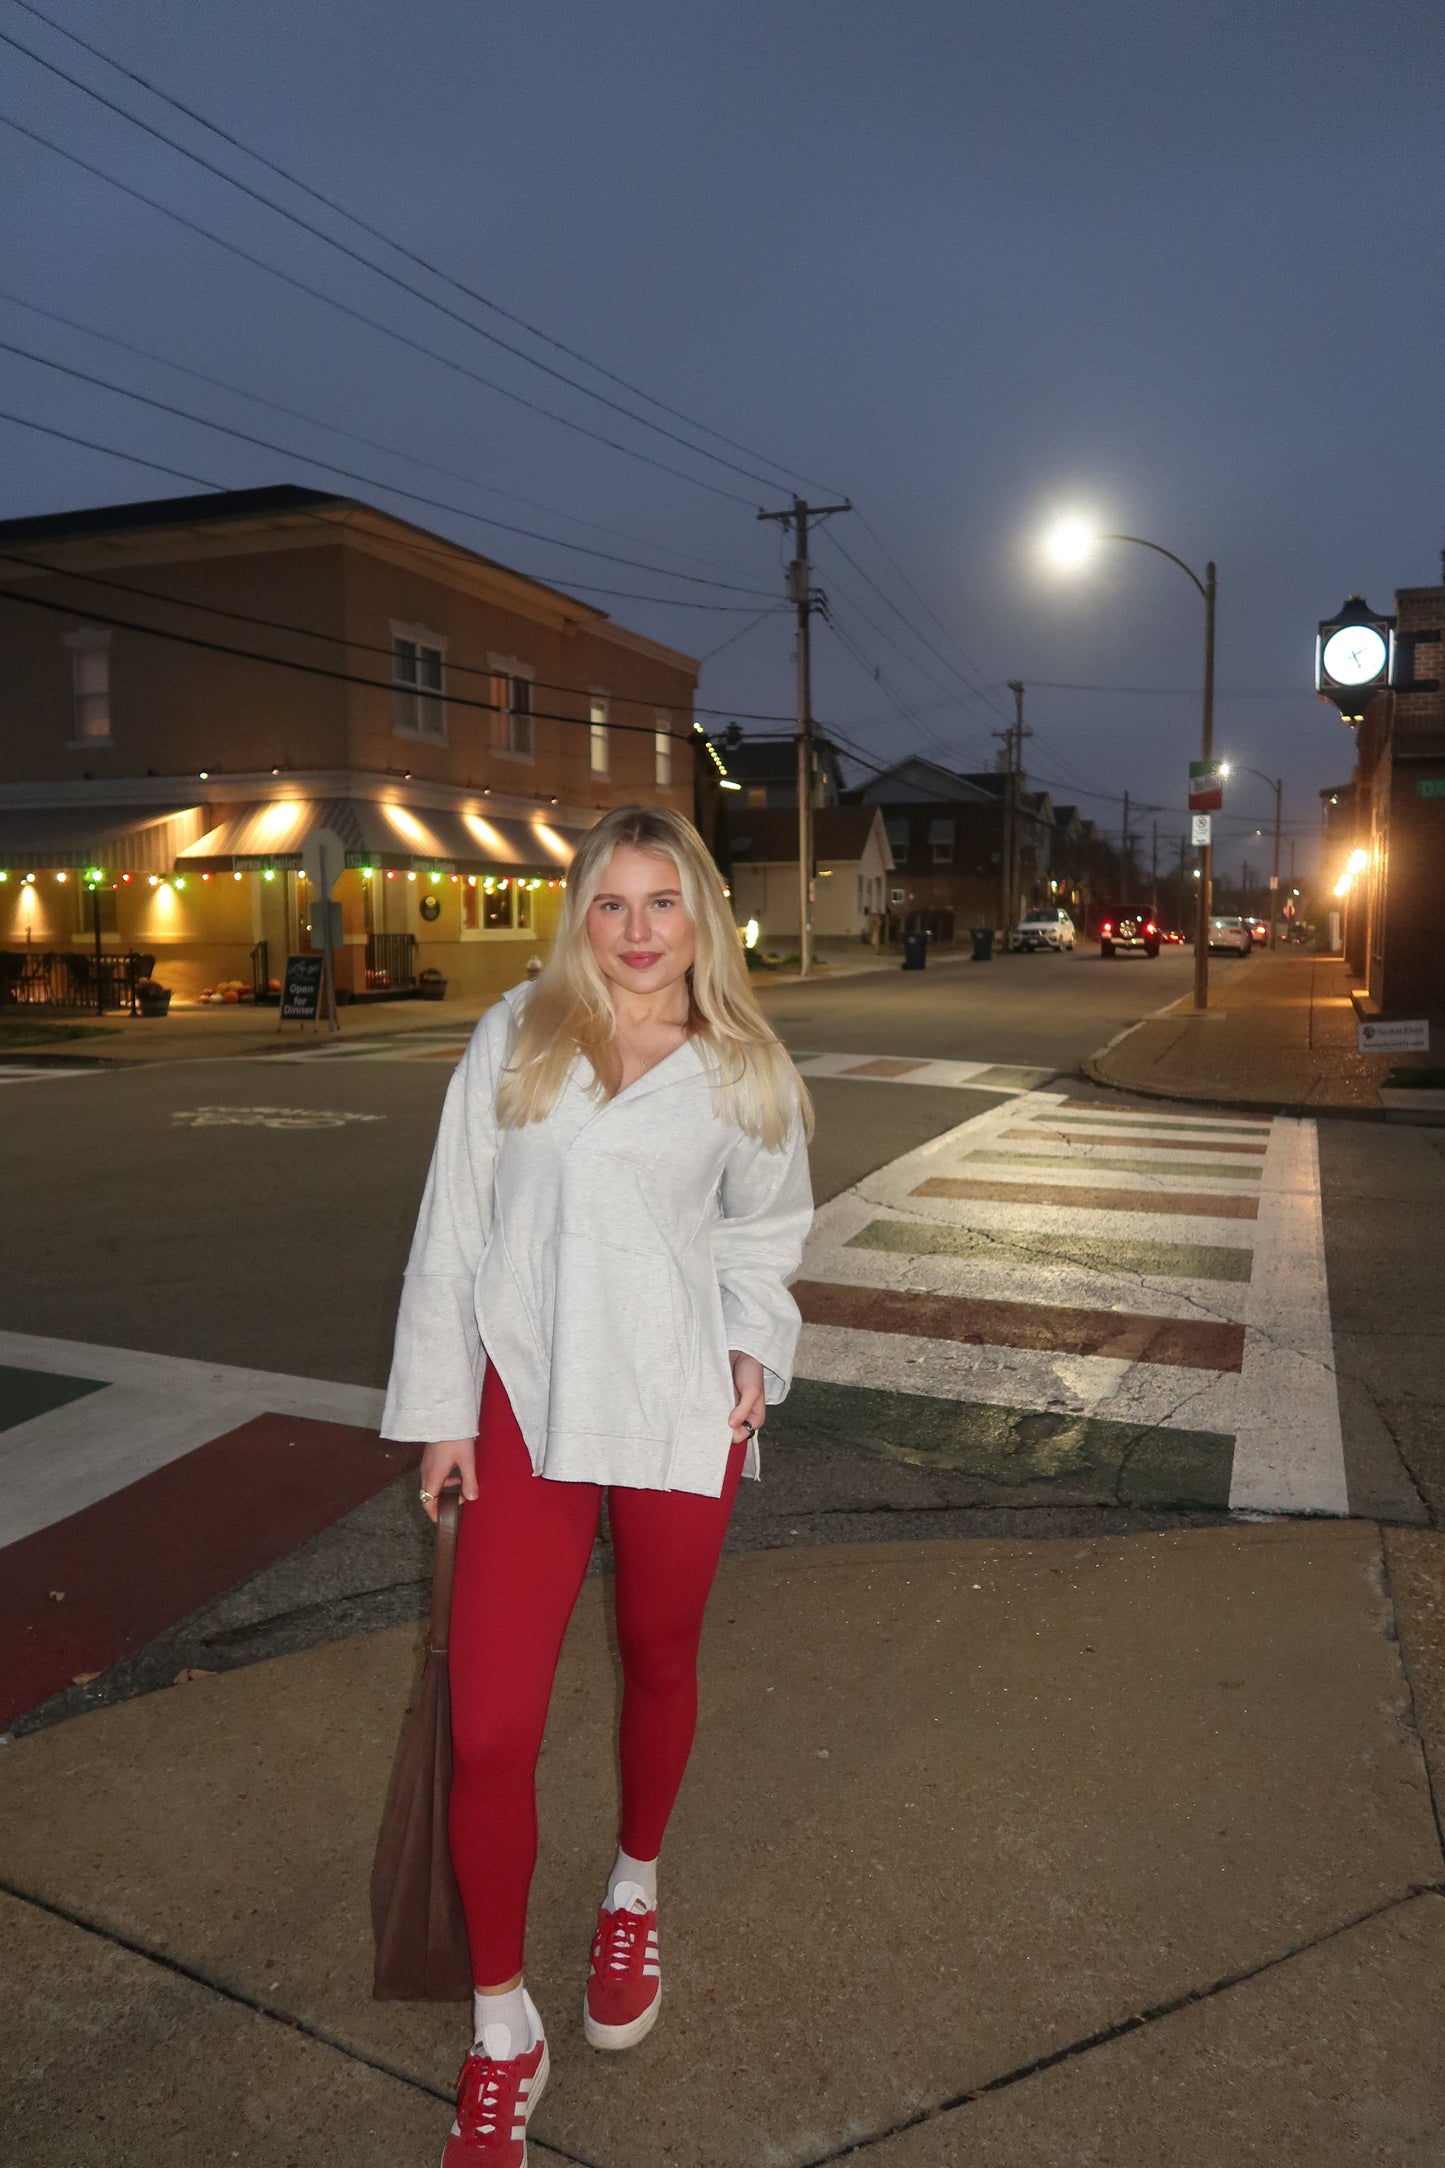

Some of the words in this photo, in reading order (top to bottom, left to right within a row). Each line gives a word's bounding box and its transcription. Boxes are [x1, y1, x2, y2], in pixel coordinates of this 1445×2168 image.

[289, 984, 313, 995] Open
[293, 996, 307, 1006] for
[283, 1005, 314, 1015] Dinner
